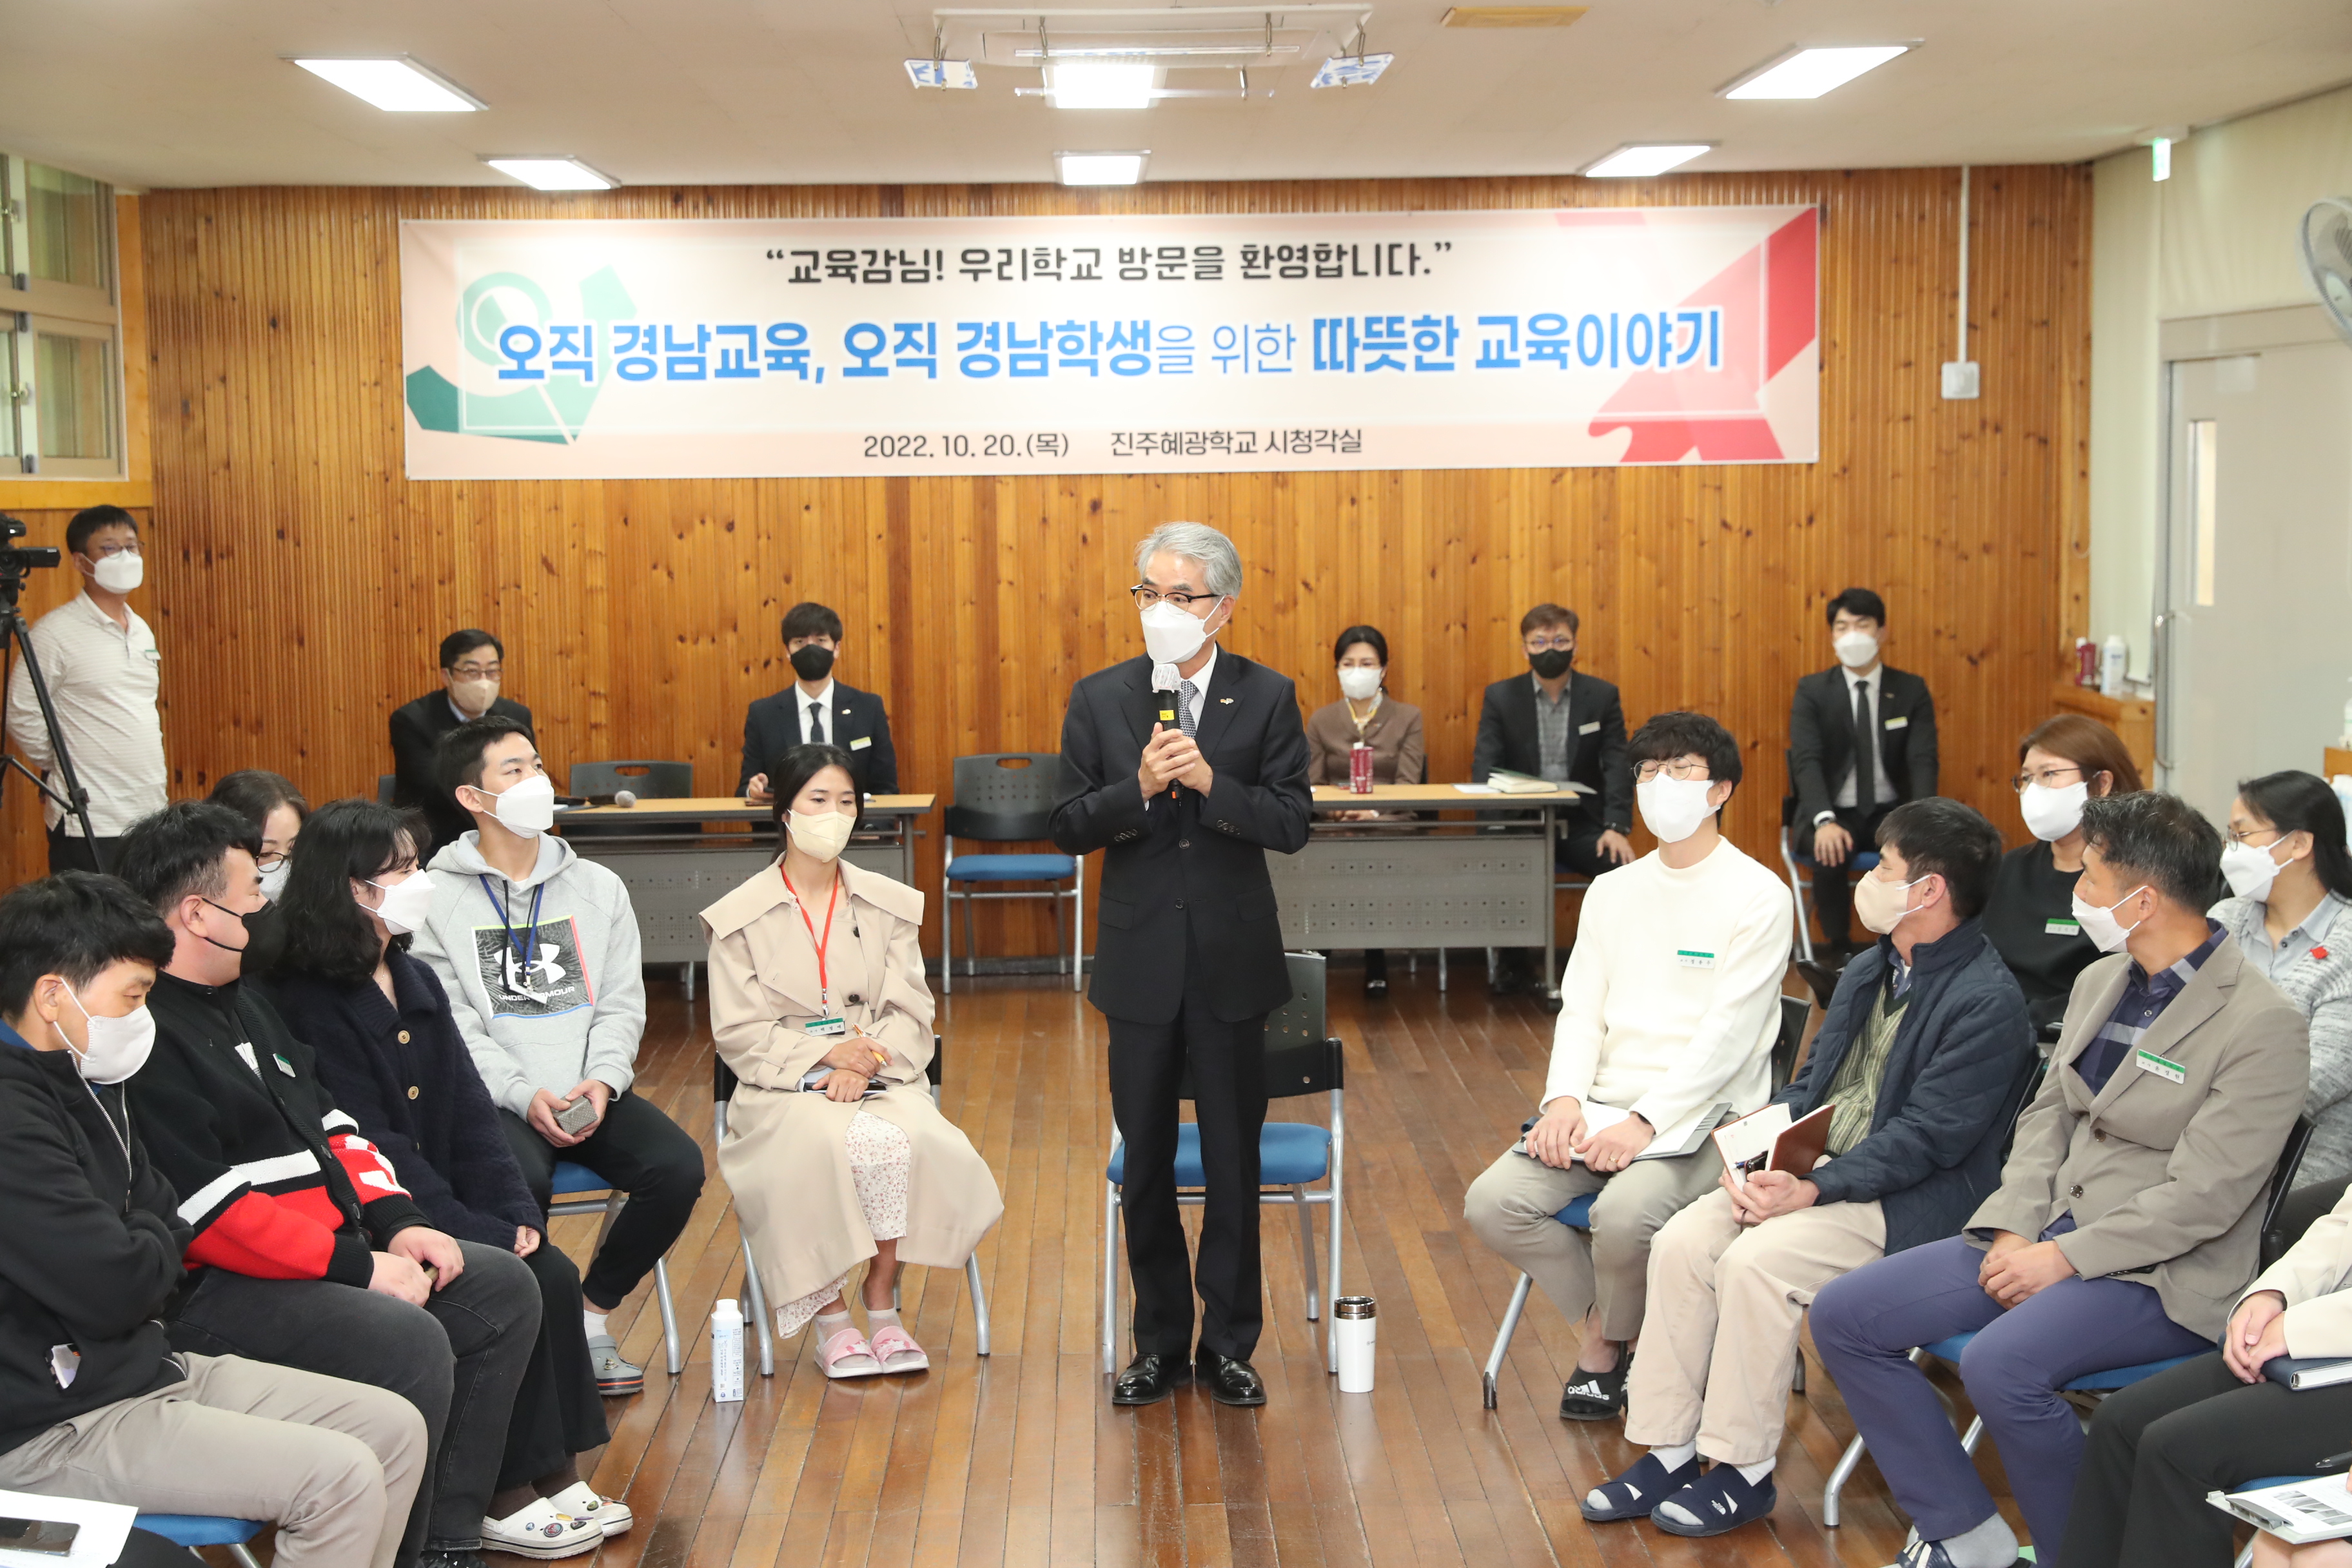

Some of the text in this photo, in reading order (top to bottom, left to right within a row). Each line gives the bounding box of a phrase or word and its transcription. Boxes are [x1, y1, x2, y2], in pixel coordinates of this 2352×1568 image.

[767, 242, 1451, 284] “교육감님! 우리학교 방문을 환영합니다.”
[498, 311, 1718, 384] 오직 경남교육, 오직 경남학생을 위한 따뜻한 교육이야기
[1111, 431, 1258, 456] 진주혜광학교
[1265, 429, 1362, 453] 시청각실
